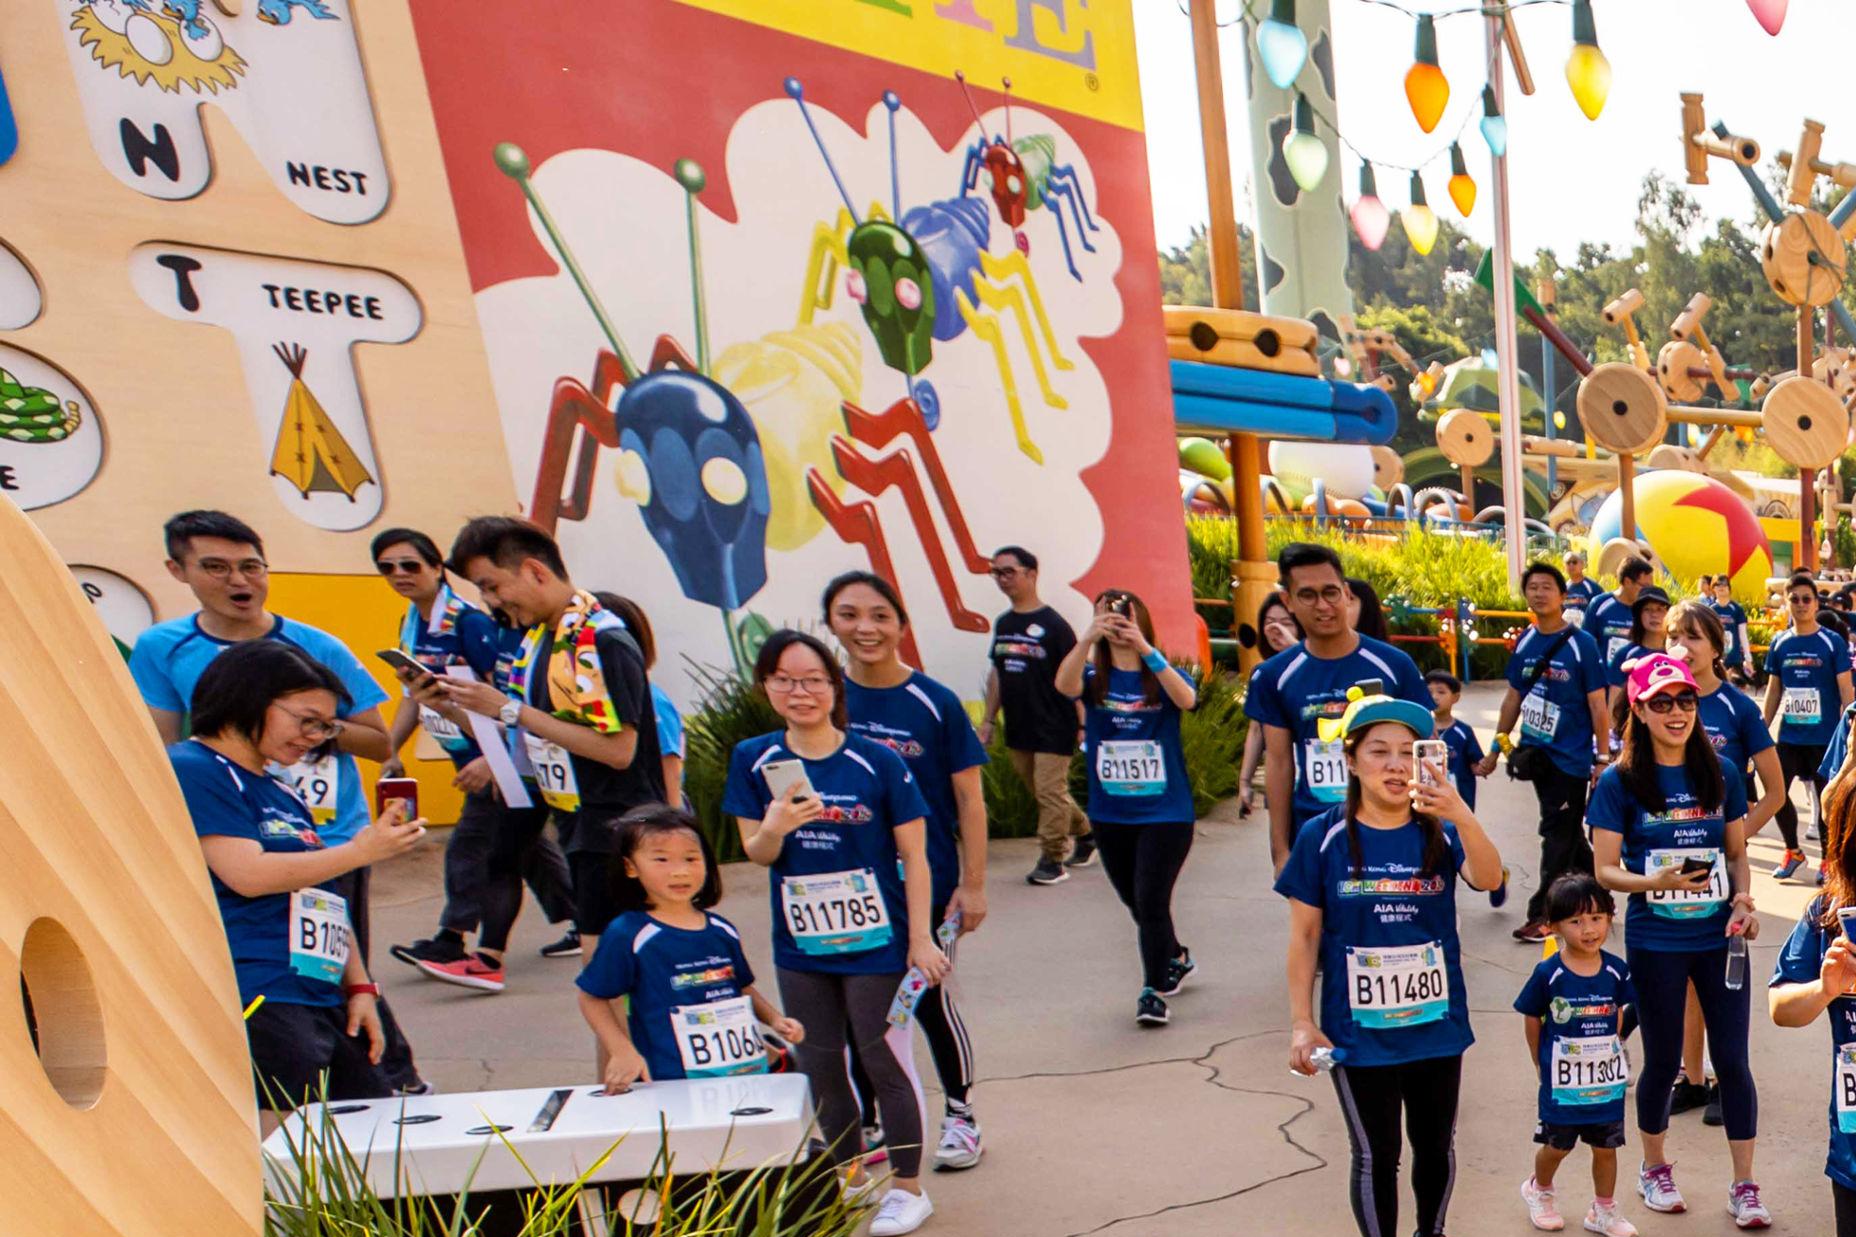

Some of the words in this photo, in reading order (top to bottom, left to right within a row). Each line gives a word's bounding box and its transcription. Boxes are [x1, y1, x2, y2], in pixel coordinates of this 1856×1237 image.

[119, 116, 180, 183] N
[286, 160, 367, 196] NEST
[156, 254, 202, 312] T
[261, 284, 384, 320] TEEPEE
[1102, 759, 1159, 779] B11517
[1312, 760, 1345, 783] B11
[789, 895, 881, 932] B11785
[1373, 903, 1394, 913] AIA
[1356, 969, 1443, 1005] B11480
